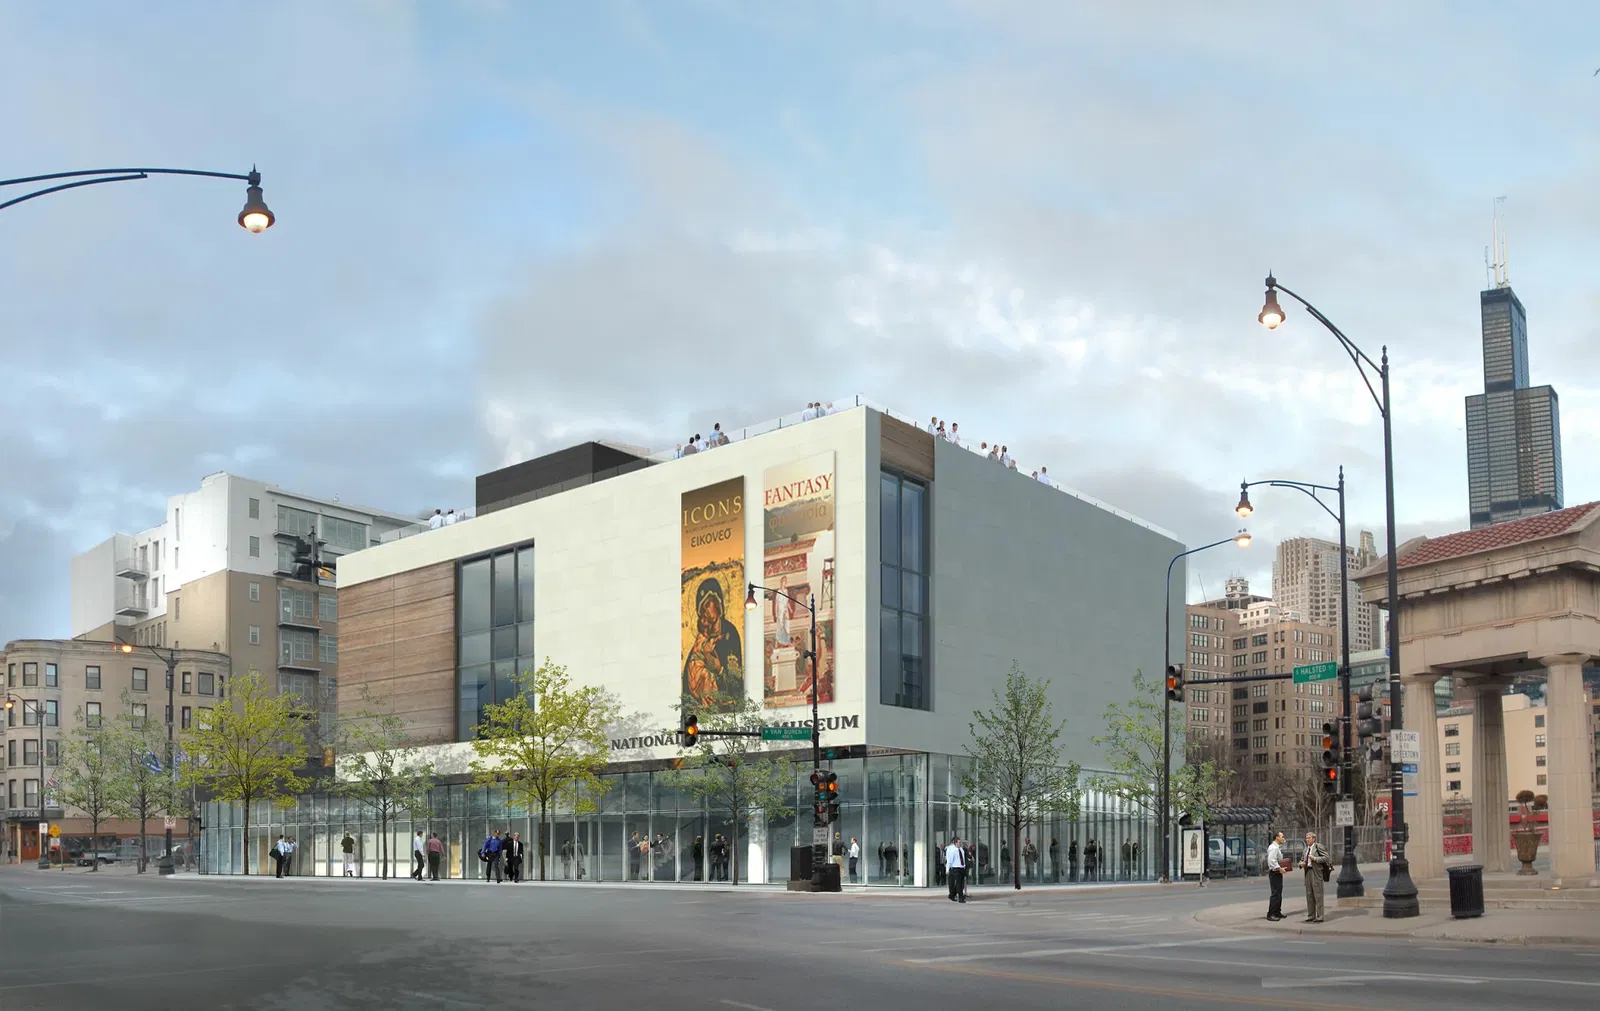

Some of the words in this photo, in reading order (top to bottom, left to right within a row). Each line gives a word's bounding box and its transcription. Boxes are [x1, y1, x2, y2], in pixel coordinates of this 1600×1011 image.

[765, 473, 833, 505] FANTASY
[683, 496, 742, 526] ICONS
[1300, 665, 1326, 674] HALSTED
[1395, 733, 1416, 742] WELCOME
[1394, 750, 1418, 758] GREEKTOWN
